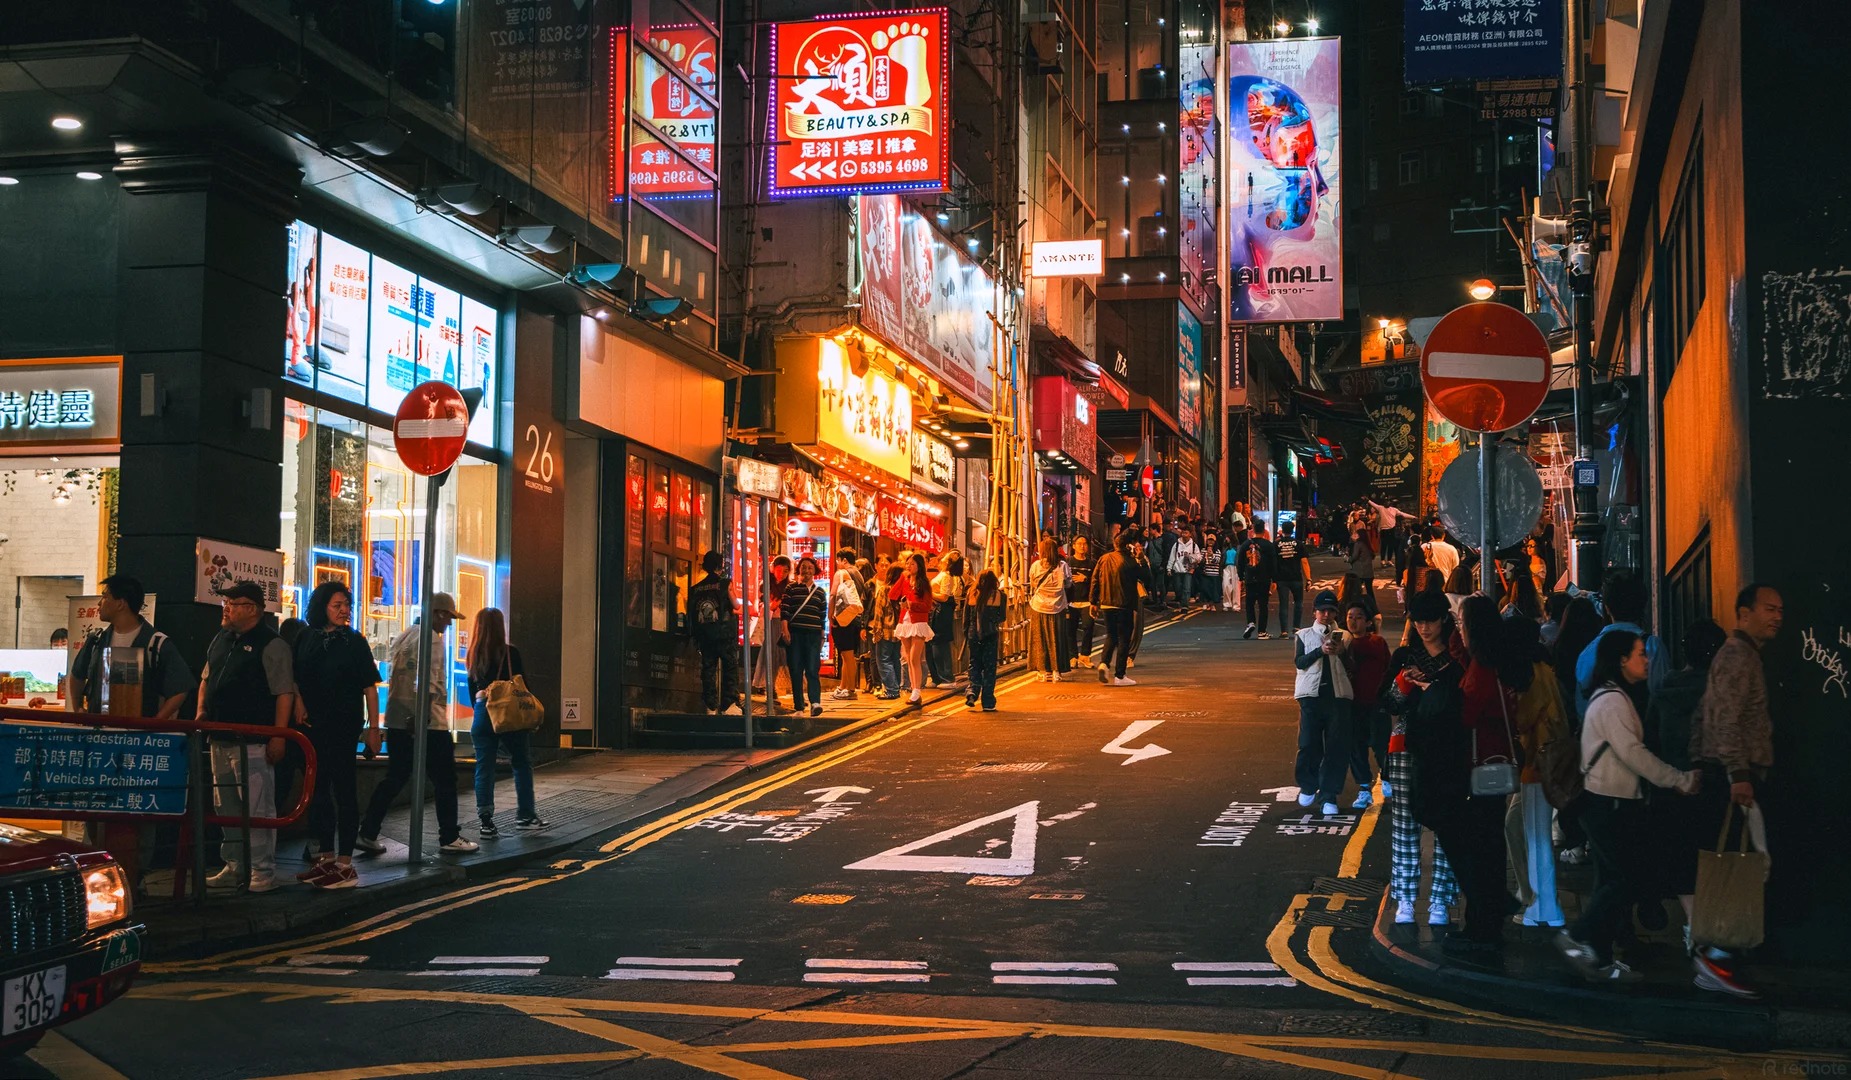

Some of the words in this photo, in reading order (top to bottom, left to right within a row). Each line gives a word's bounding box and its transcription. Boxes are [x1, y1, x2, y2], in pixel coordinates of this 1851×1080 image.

[1507, 28, 1543, 39] 有限公司
[1502, 108, 1528, 118] 2988
[800, 141, 832, 158] 足浴
[842, 139, 874, 157] 美容
[885, 136, 917, 153] 推拿
[860, 160, 893, 175] 5395
[895, 157, 929, 173] 4698
[1040, 253, 1095, 263] AMANTE
[1237, 265, 1260, 287] AI
[1267, 265, 1334, 284] MALL
[525, 424, 554, 483] 26
[1382, 465, 1392, 476] IT
[144, 735, 171, 748] Area
[45, 771, 95, 785] Vehicles
[99, 774, 160, 787] Prohibited
[120, 938, 128, 956] 4
[110, 953, 133, 969] SEATS
[22, 969, 48, 1002] KX
